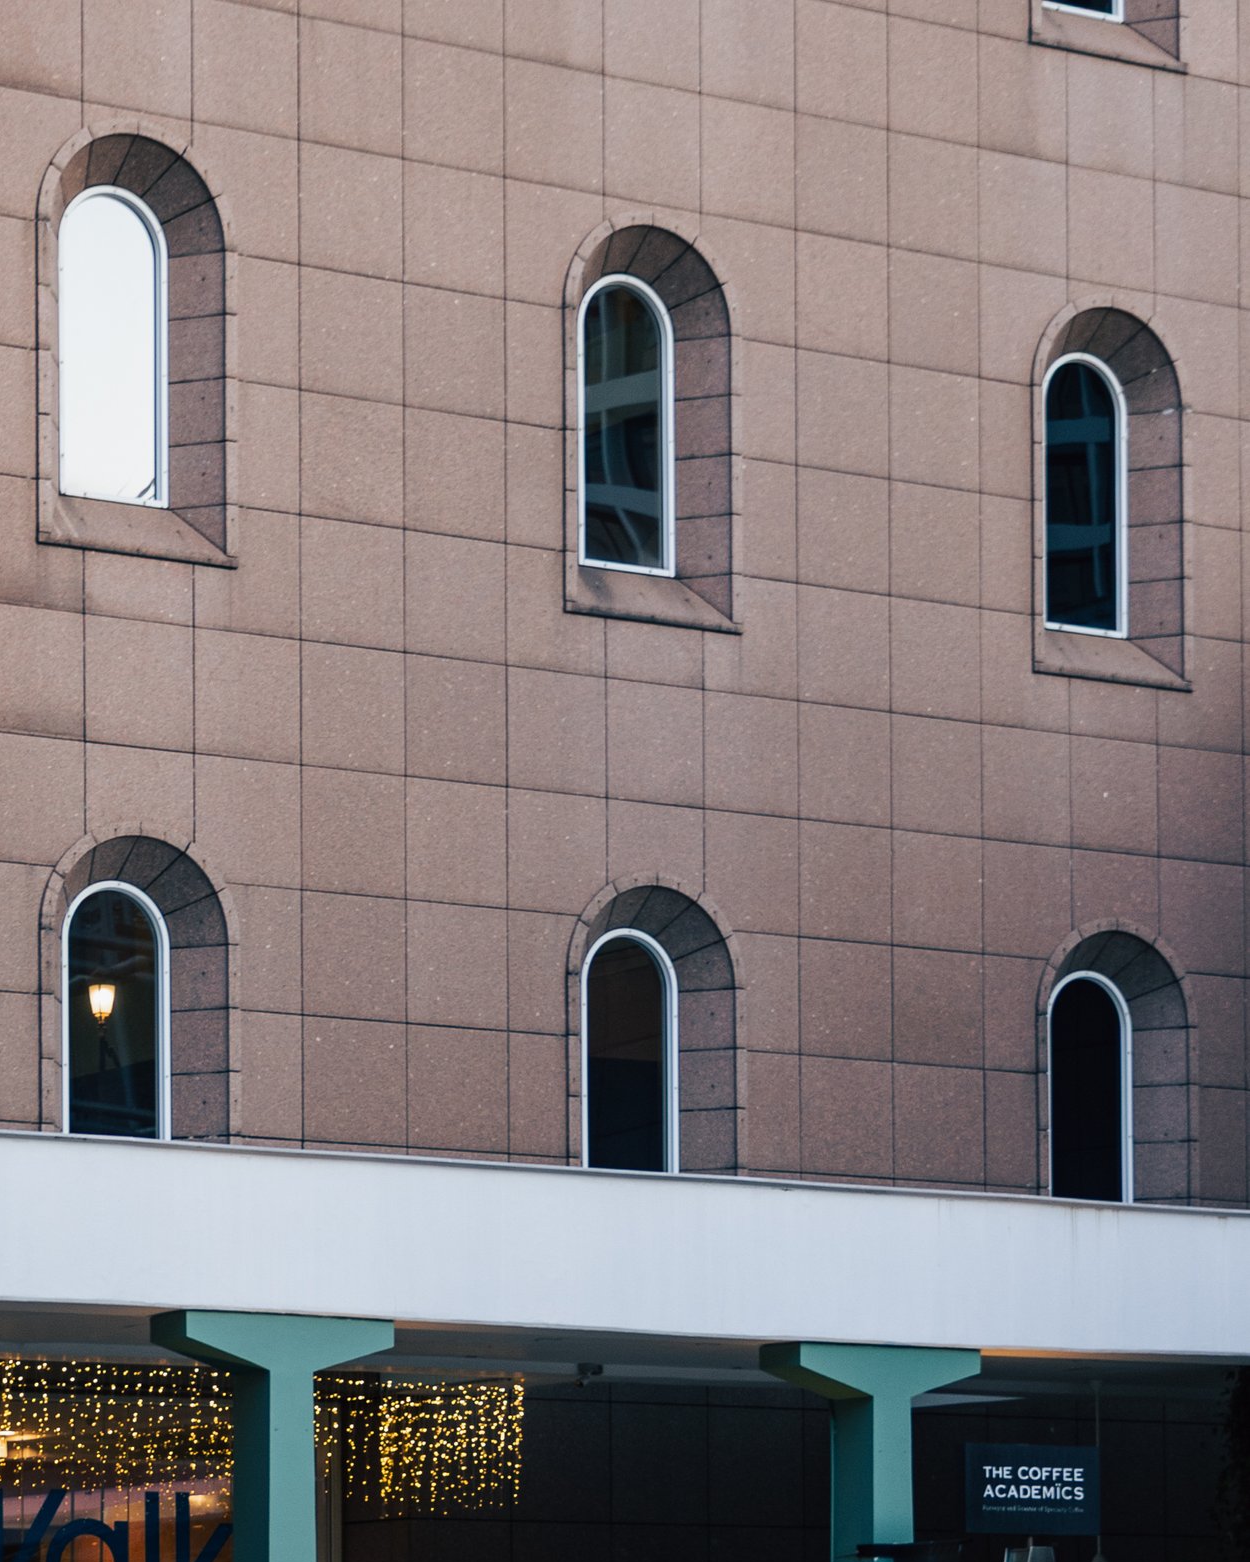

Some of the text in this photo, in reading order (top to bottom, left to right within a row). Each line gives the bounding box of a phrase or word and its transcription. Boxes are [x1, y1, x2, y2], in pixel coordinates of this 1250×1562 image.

[982, 1466, 1085, 1482] THE COFFEE
[982, 1483, 1085, 1500] ACADEMÏCS
